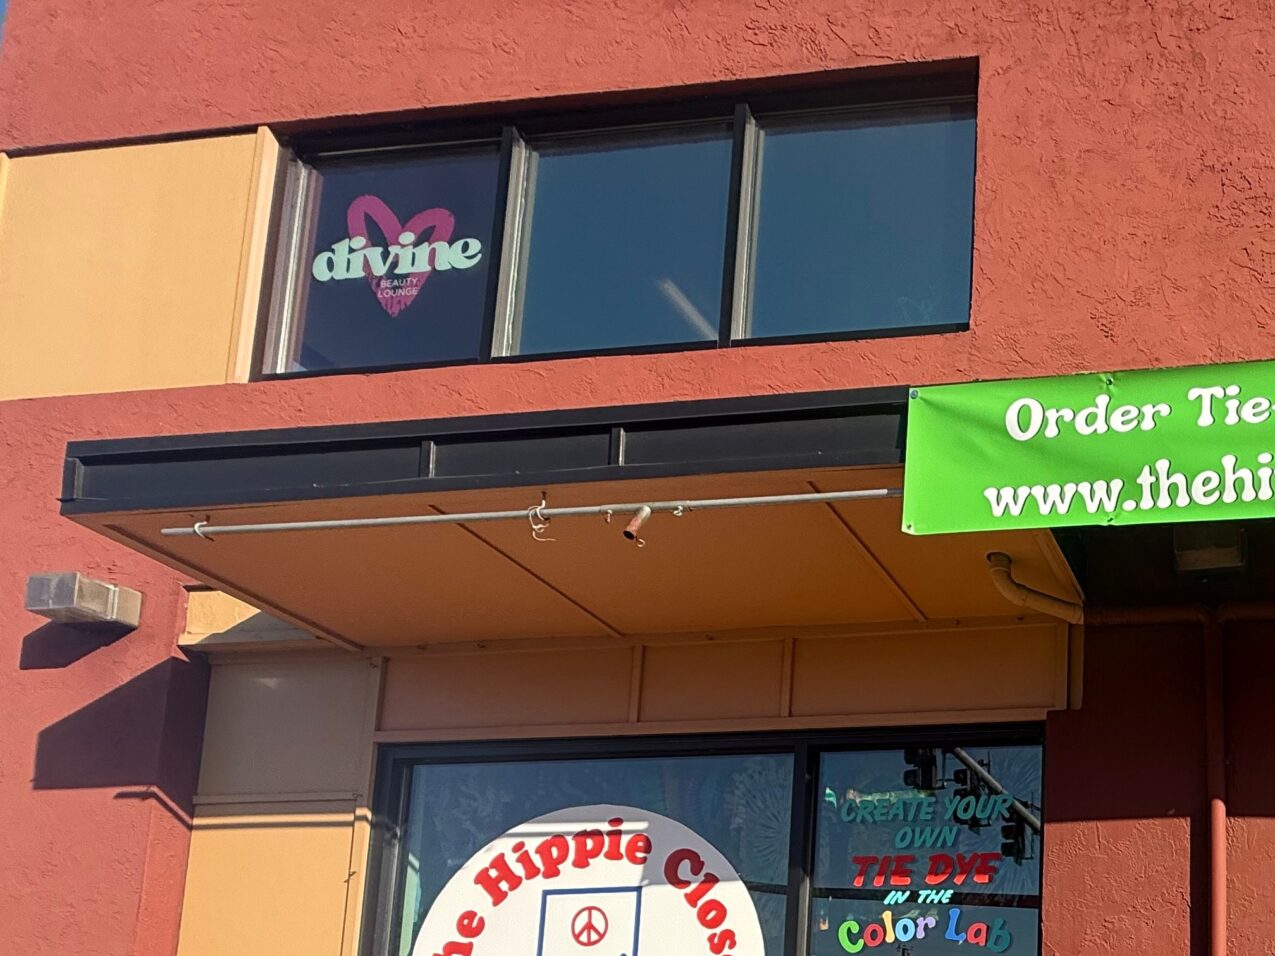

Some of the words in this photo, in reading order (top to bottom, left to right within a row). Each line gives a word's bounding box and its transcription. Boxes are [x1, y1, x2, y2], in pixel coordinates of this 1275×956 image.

[312, 231, 482, 281] divine
[378, 287, 418, 298] LOUNGE
[380, 278, 418, 288] BEAUTY
[1005, 394, 1171, 441] Order
[840, 796, 936, 824] CREATE
[943, 793, 1014, 821] YOUR
[894, 826, 960, 849] OWN
[473, 817, 652, 907] Hippie
[852, 854, 915, 887] TIE
[924, 852, 1003, 886] DYE
[883, 890, 911, 905] IN
[917, 889, 954, 904] THE
[838, 910, 936, 954] Color
[944, 908, 1012, 953] Lab
